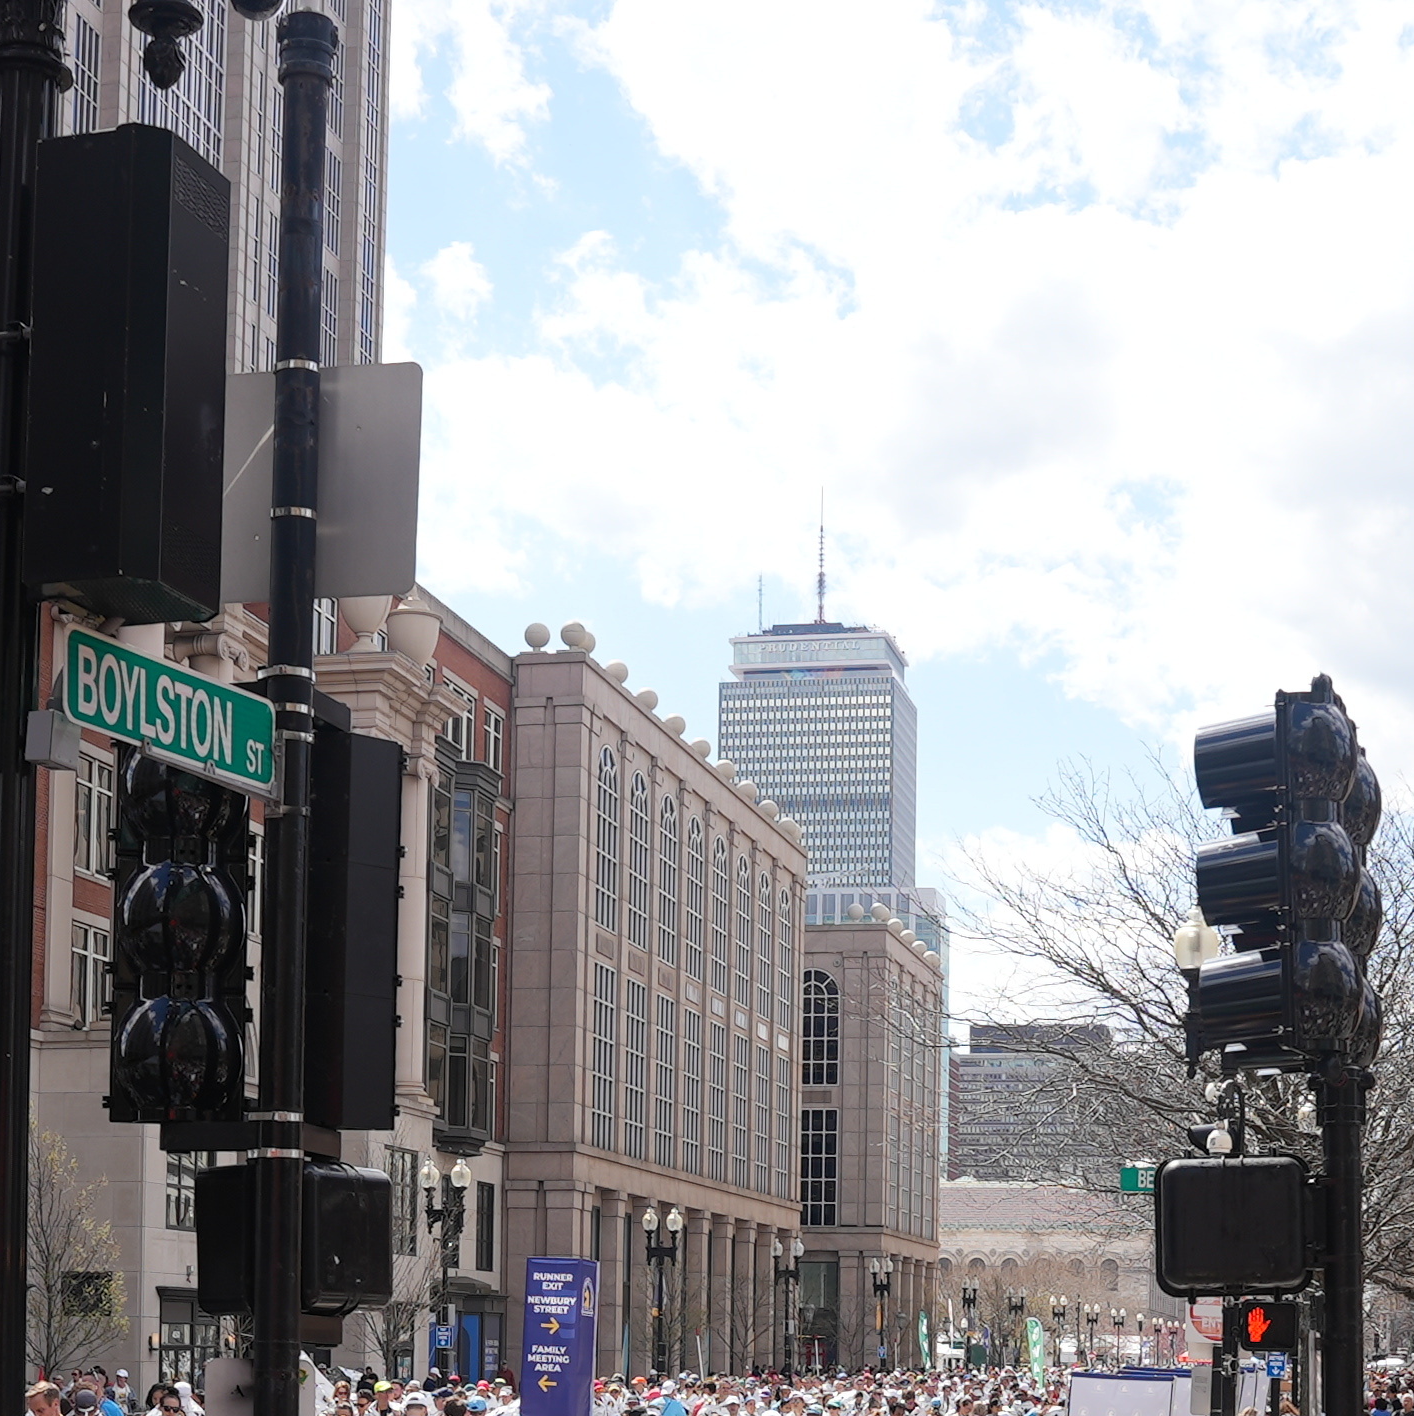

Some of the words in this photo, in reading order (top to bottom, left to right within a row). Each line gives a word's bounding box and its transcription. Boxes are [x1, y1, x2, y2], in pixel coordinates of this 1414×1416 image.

[77, 643, 233, 766] BOYLSTON
[245, 738, 266, 776] ST
[1137, 1170, 1155, 1188] BE
[533, 1272, 573, 1282] RUNNER
[542, 1281, 563, 1291] EXIT
[528, 1295, 577, 1306] NEWBURY
[533, 1305, 569, 1314] STREET
[531, 1345, 567, 1355] FAMILY
[527, 1354, 570, 1363] MEETING
[534, 1363, 561, 1372] AREA
